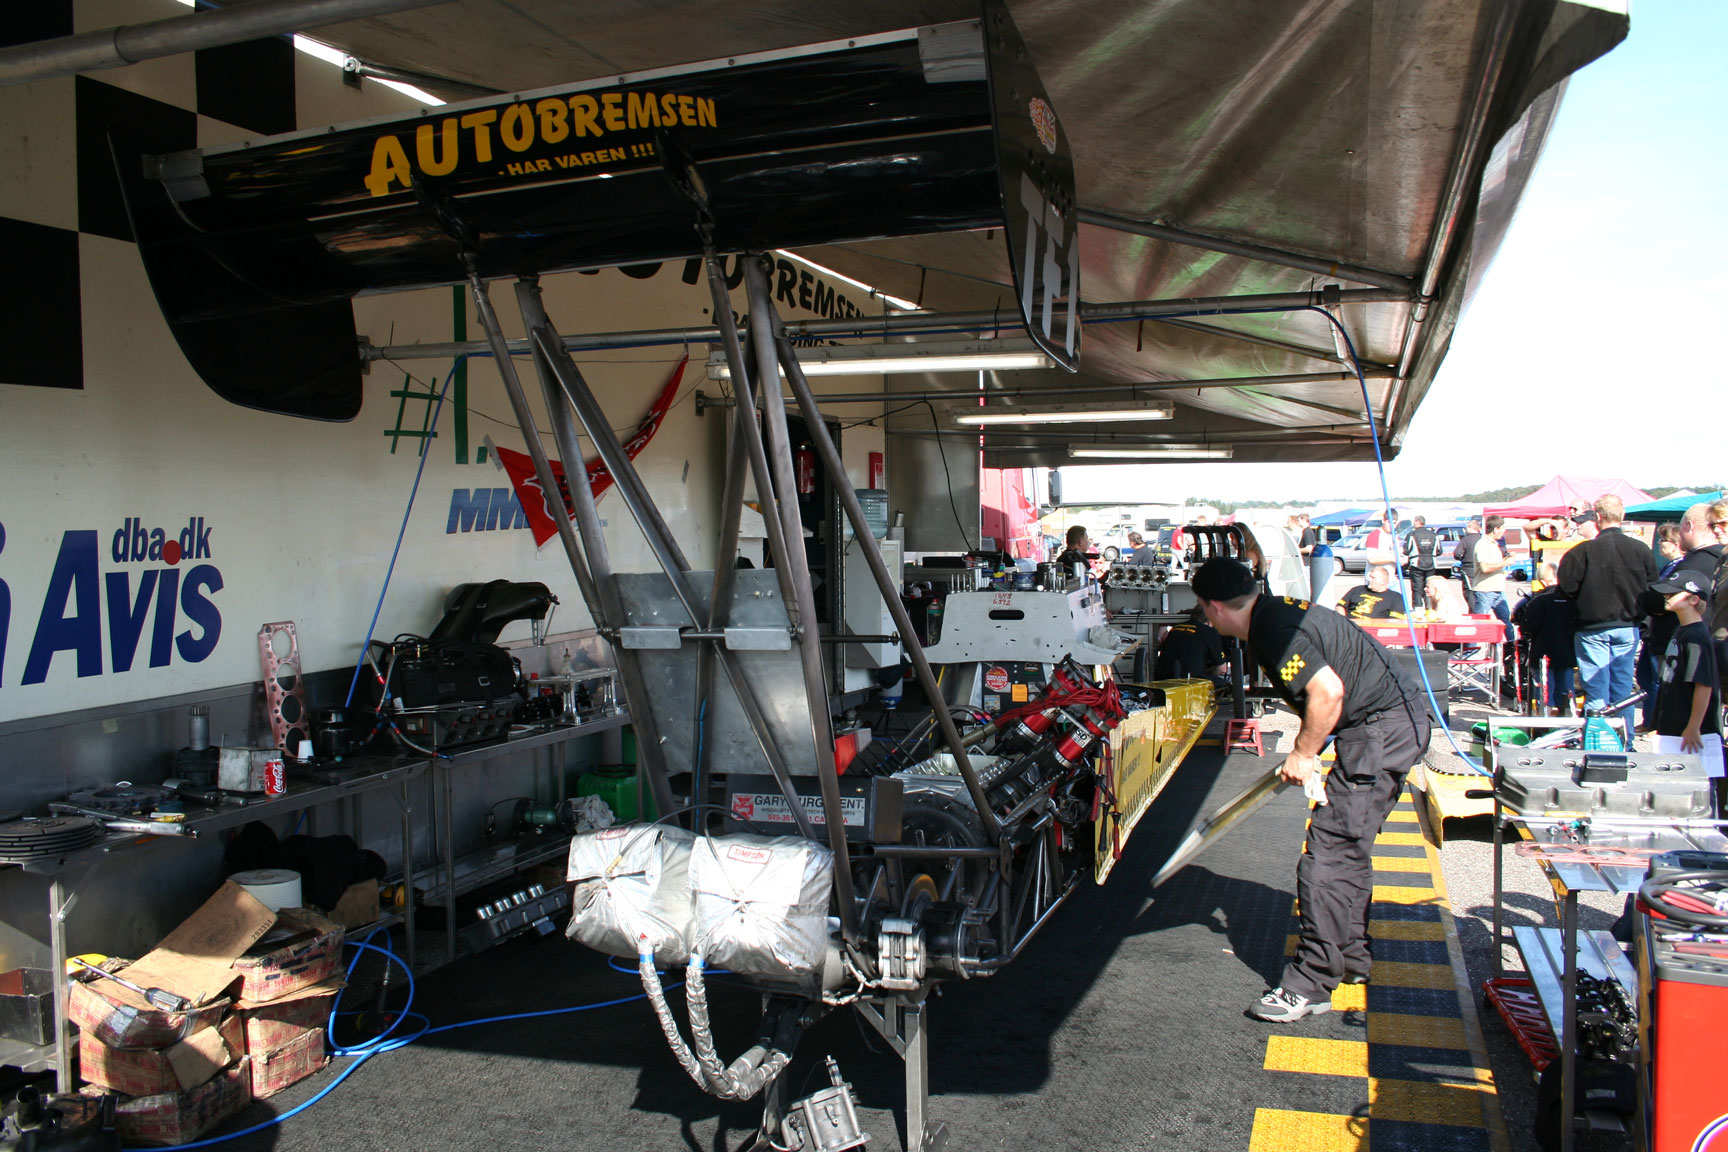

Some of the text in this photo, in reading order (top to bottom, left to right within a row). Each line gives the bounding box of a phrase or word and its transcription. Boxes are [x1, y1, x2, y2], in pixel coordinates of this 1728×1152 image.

[364, 92, 718, 197] AUTOBREMSEN
[506, 159, 553, 176] HAR
[555, 146, 627, 170] VAREN
[112, 516, 213, 566] dba.dk
